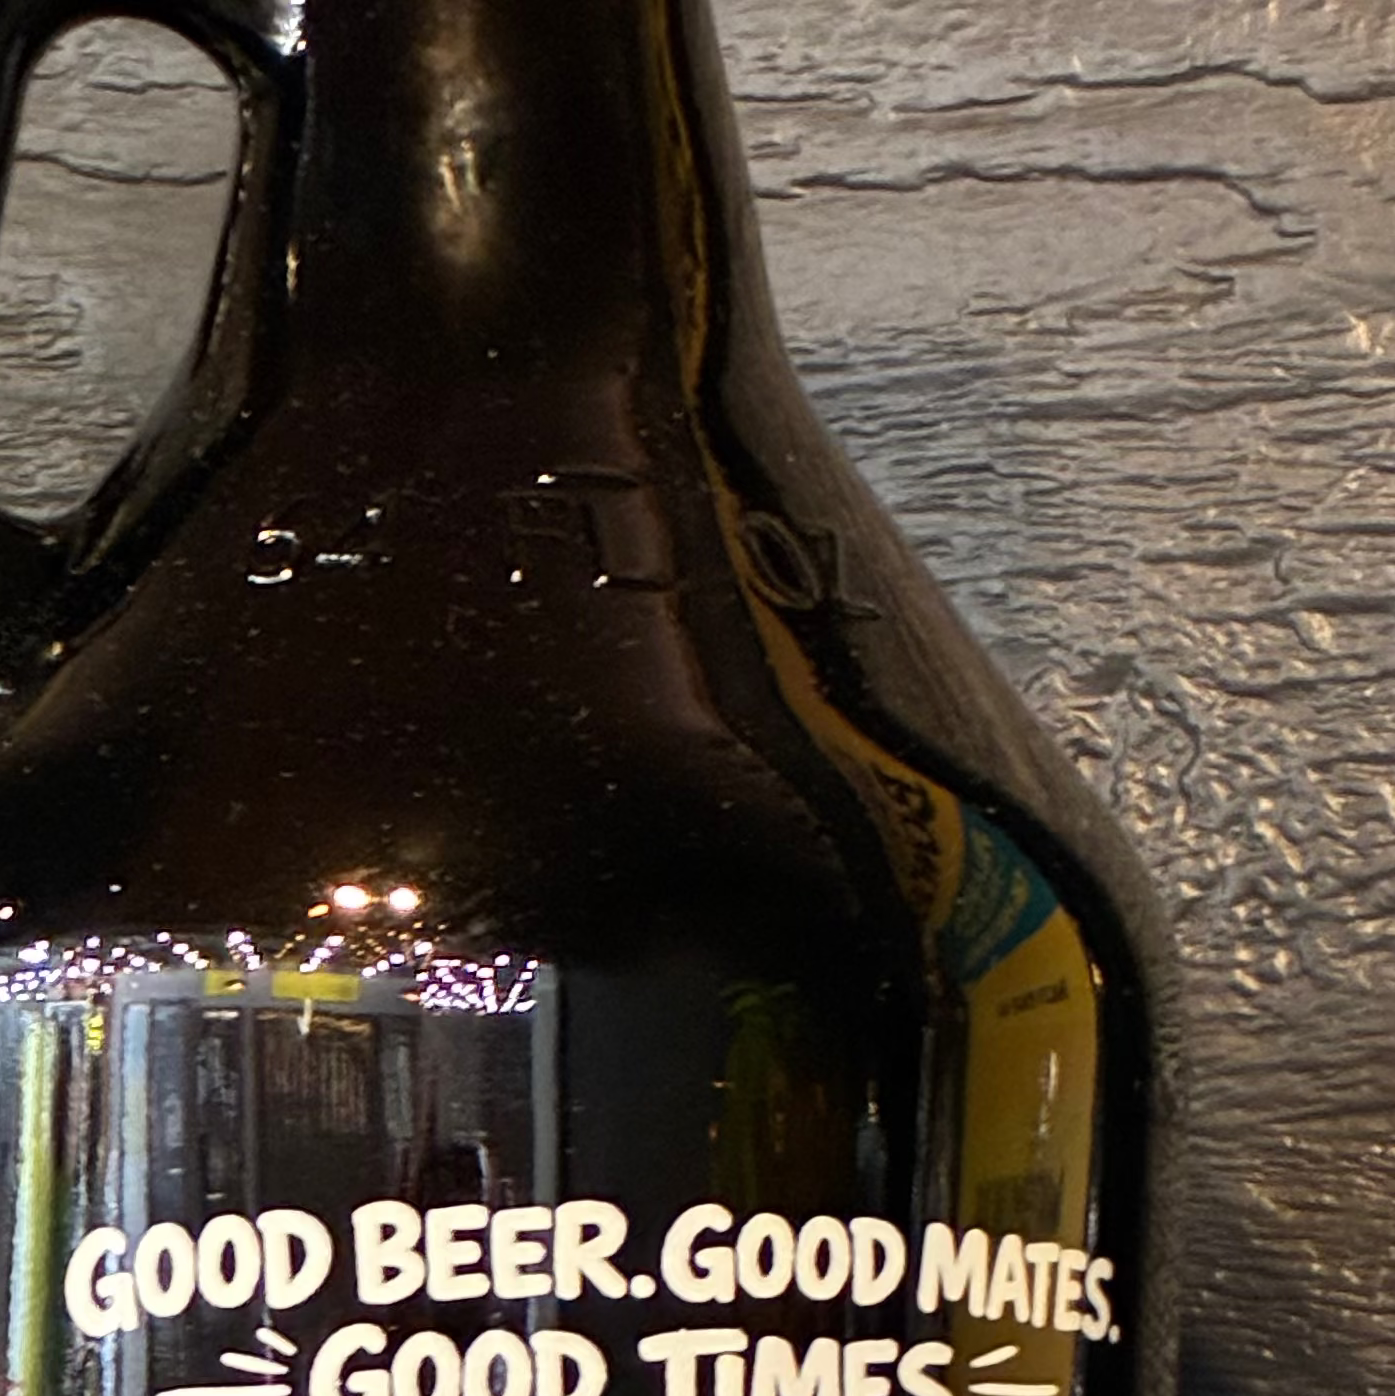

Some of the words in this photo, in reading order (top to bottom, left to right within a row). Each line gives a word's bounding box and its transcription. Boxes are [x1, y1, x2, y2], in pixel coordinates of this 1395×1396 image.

[64, 1208, 335, 1338] GOOD
[351, 1200, 656, 1305] BEER.
[660, 1203, 905, 1306] GOOD
[916, 1224, 1118, 1344] MATES.
